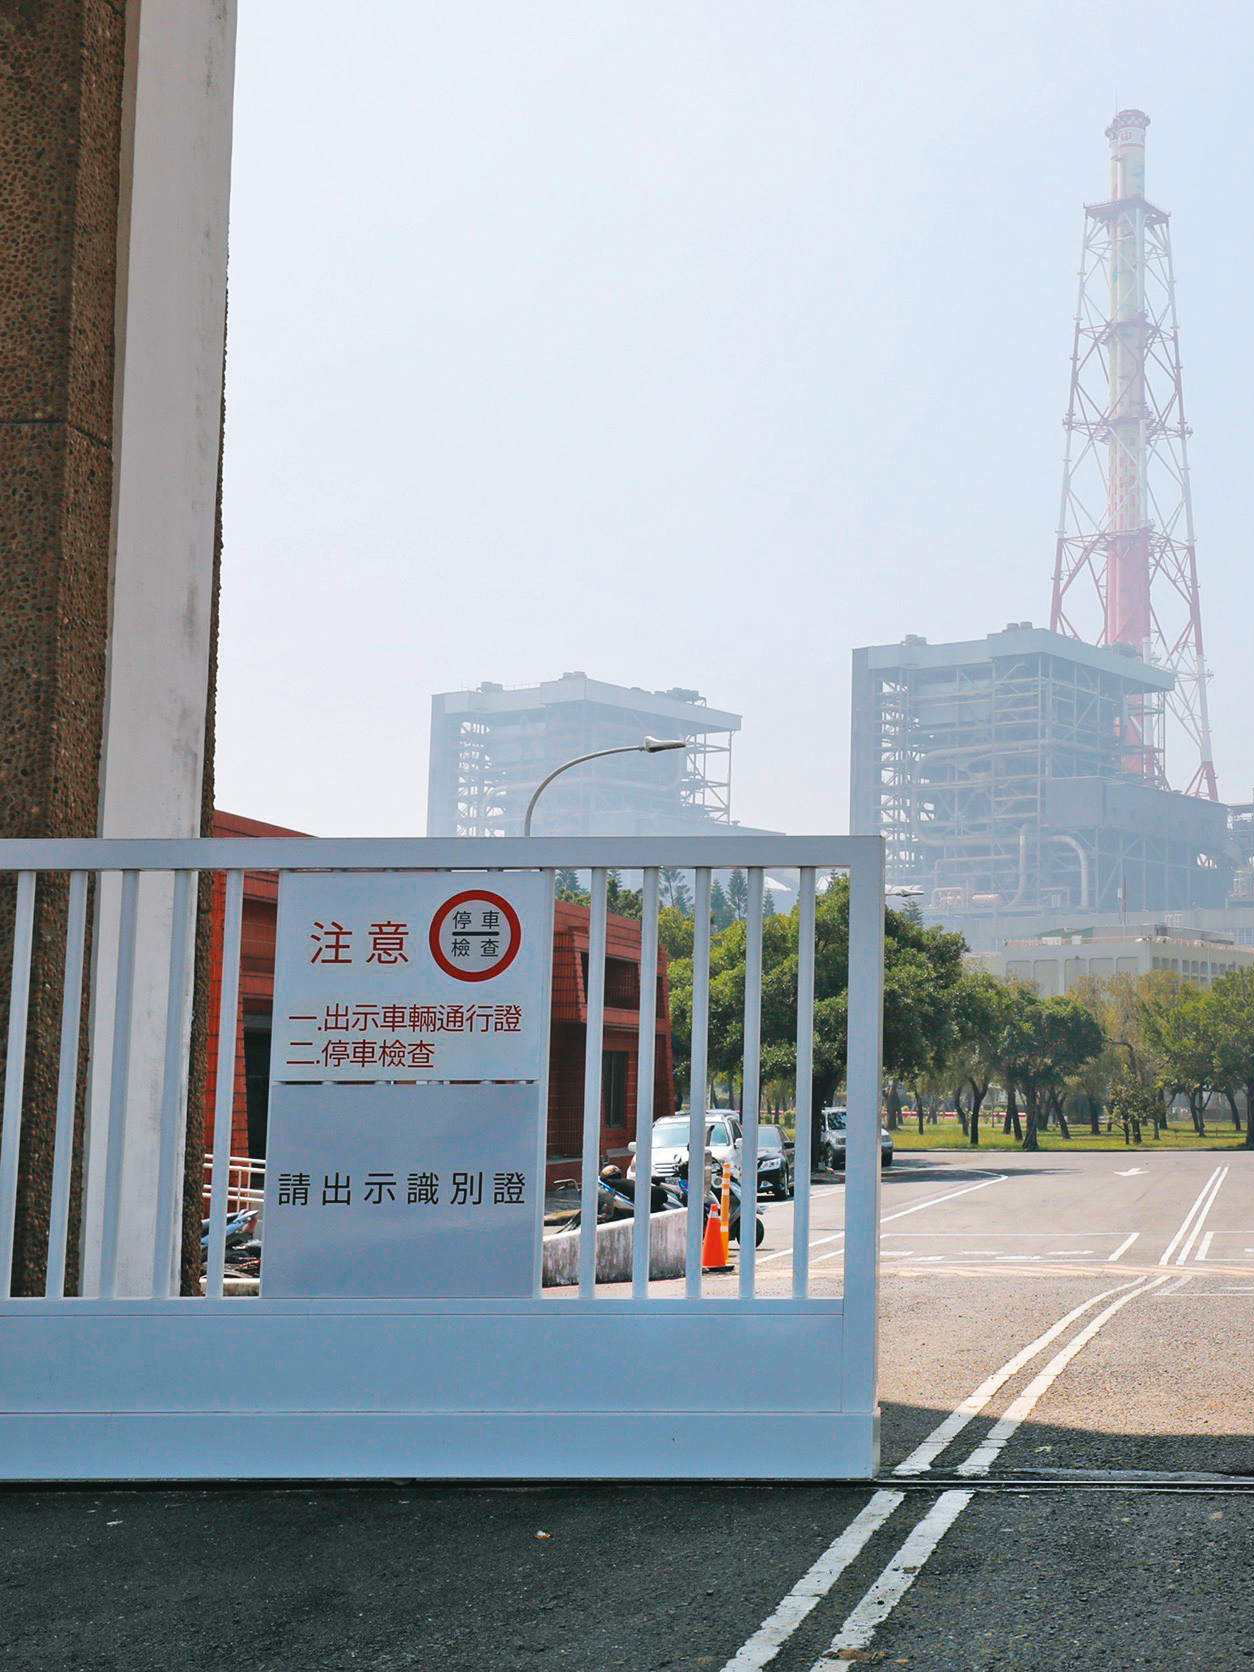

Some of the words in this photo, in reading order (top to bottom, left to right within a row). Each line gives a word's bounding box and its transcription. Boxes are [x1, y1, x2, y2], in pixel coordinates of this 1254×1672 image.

[452, 909, 501, 930] 停車
[310, 920, 410, 965] 注意
[450, 937, 500, 959] 檢查
[288, 1002, 522, 1033] 一.出示車輛通行證
[285, 1038, 436, 1069] 二.停車檢查
[278, 1171, 526, 1206] 請出示識別證
